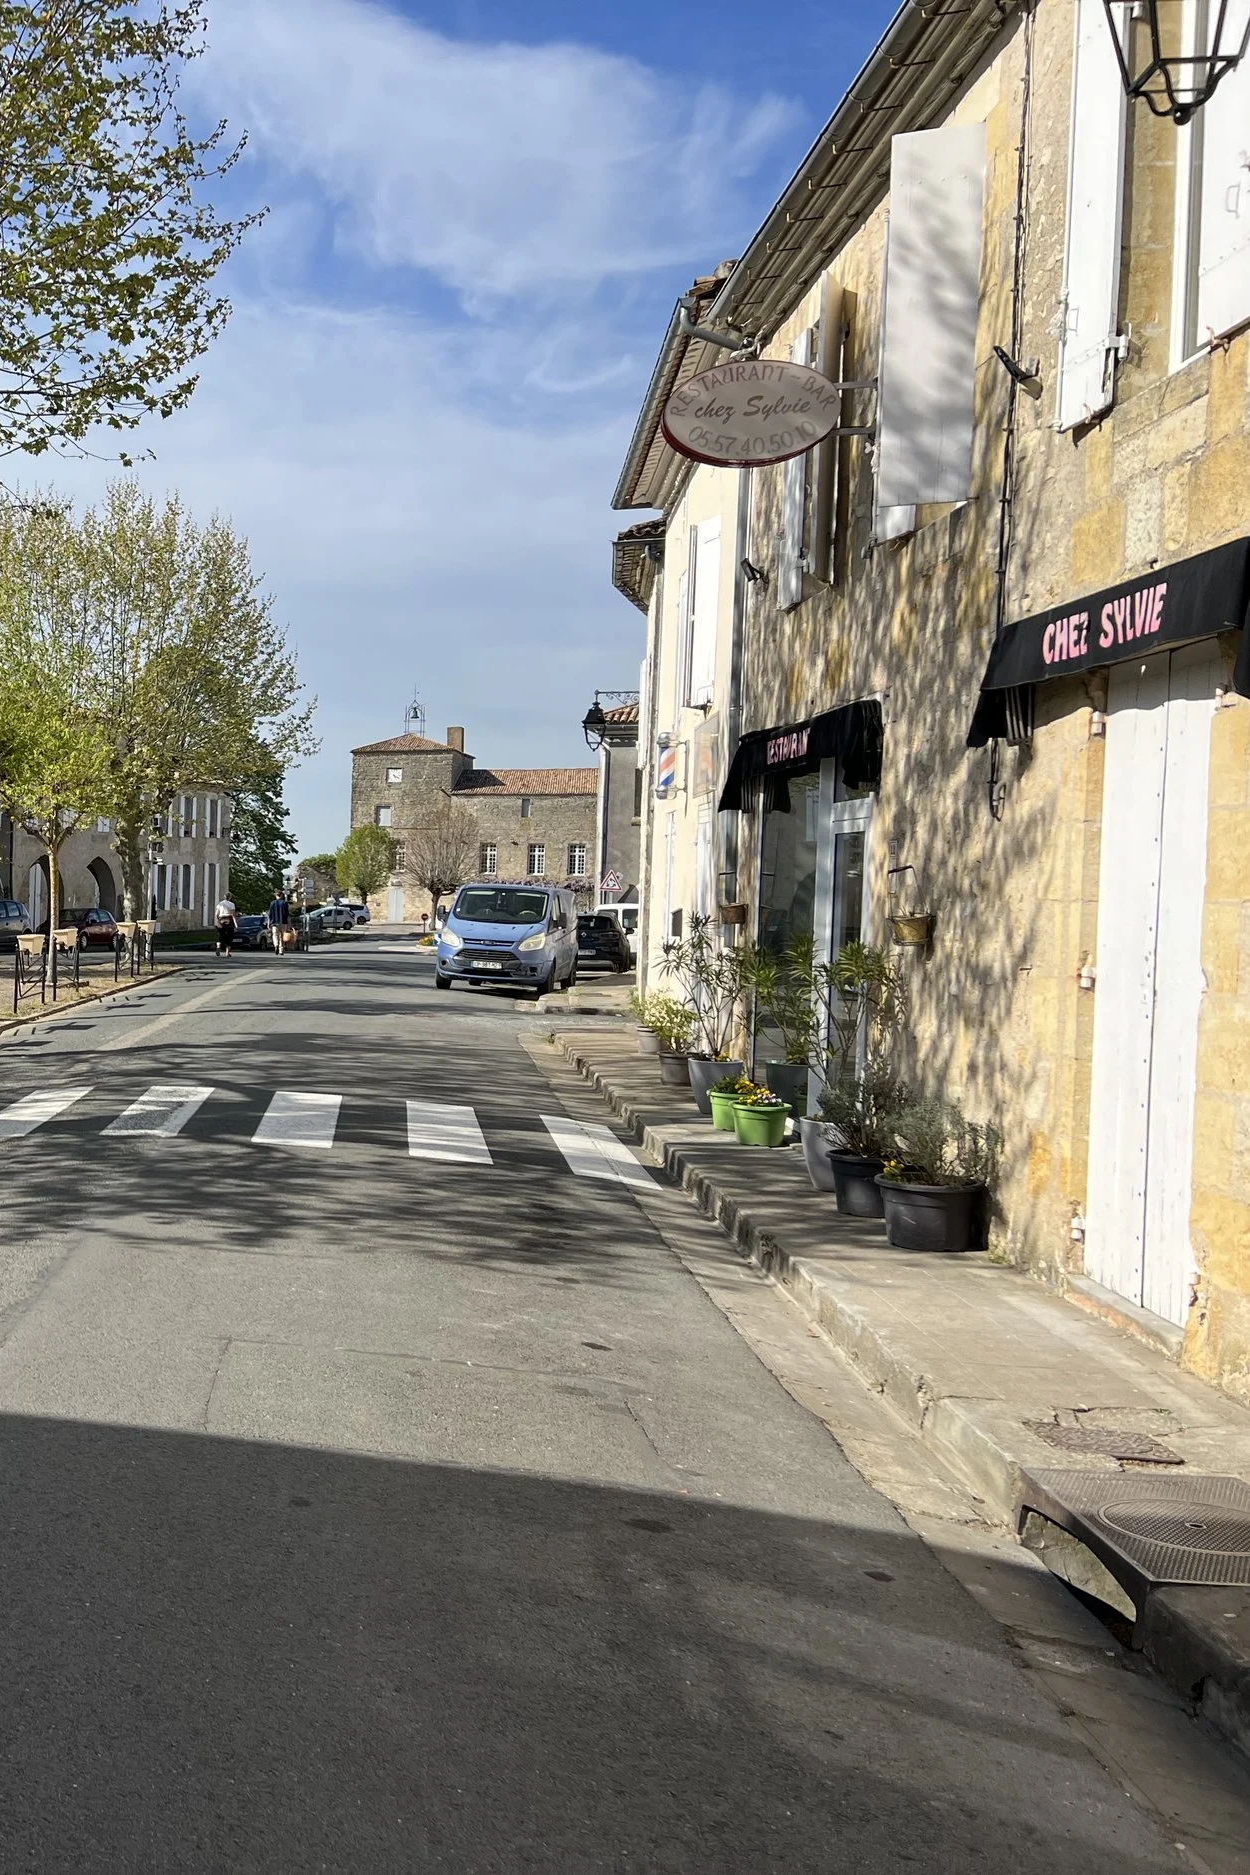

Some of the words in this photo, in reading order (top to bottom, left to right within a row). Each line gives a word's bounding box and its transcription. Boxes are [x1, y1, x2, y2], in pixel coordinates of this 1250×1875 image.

[670, 364, 790, 417] RESTAURANT
[802, 375, 837, 412] BAR
[694, 397, 736, 425] chez
[743, 395, 811, 424] Sylvie
[1042, 611, 1090, 665] CHEZ
[1099, 582, 1168, 648] SYLVIE
